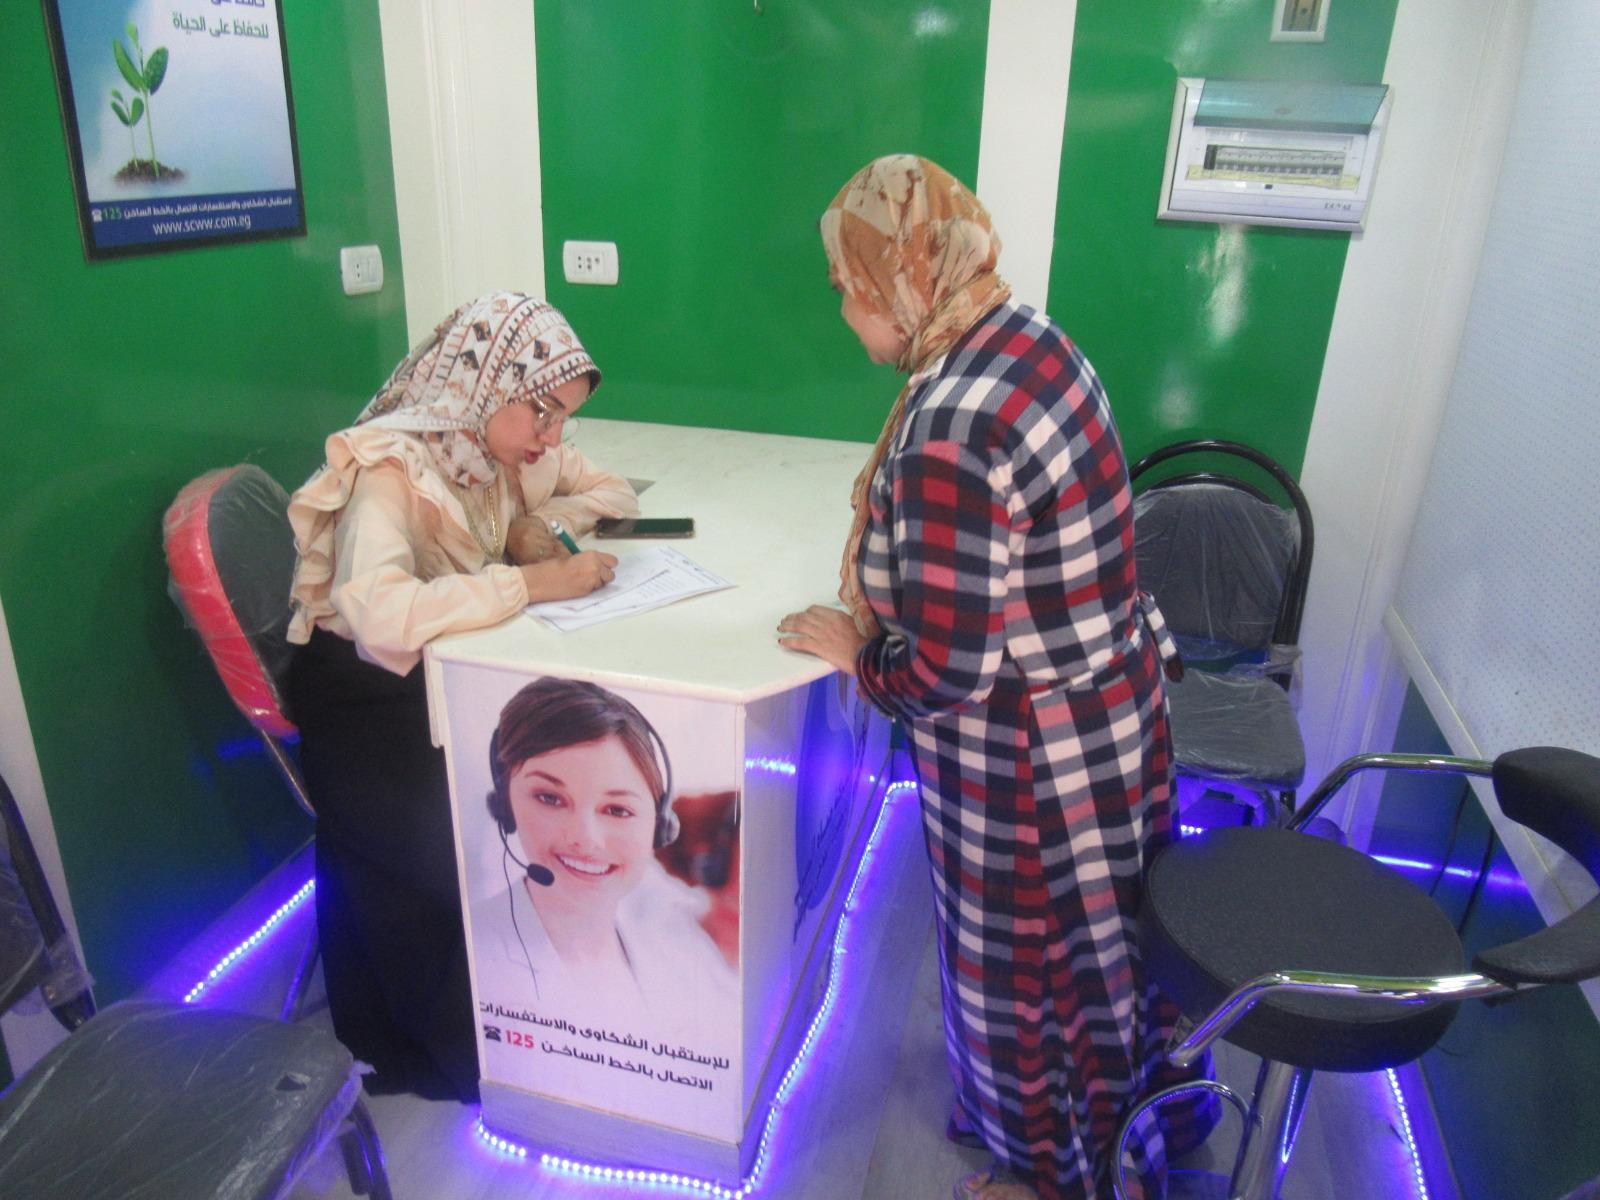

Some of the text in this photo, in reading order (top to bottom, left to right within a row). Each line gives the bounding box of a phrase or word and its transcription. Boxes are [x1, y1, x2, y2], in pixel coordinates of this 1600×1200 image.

[172, 12, 269, 38] للحفاظ على الحياة
[152, 214, 251, 236] www.scww.com.eg
[479, 1001, 730, 1070] للإستقبال الشكاوى والاستفسارات
[505, 1029, 713, 1092] الاتصال بالخط الساخن 125
